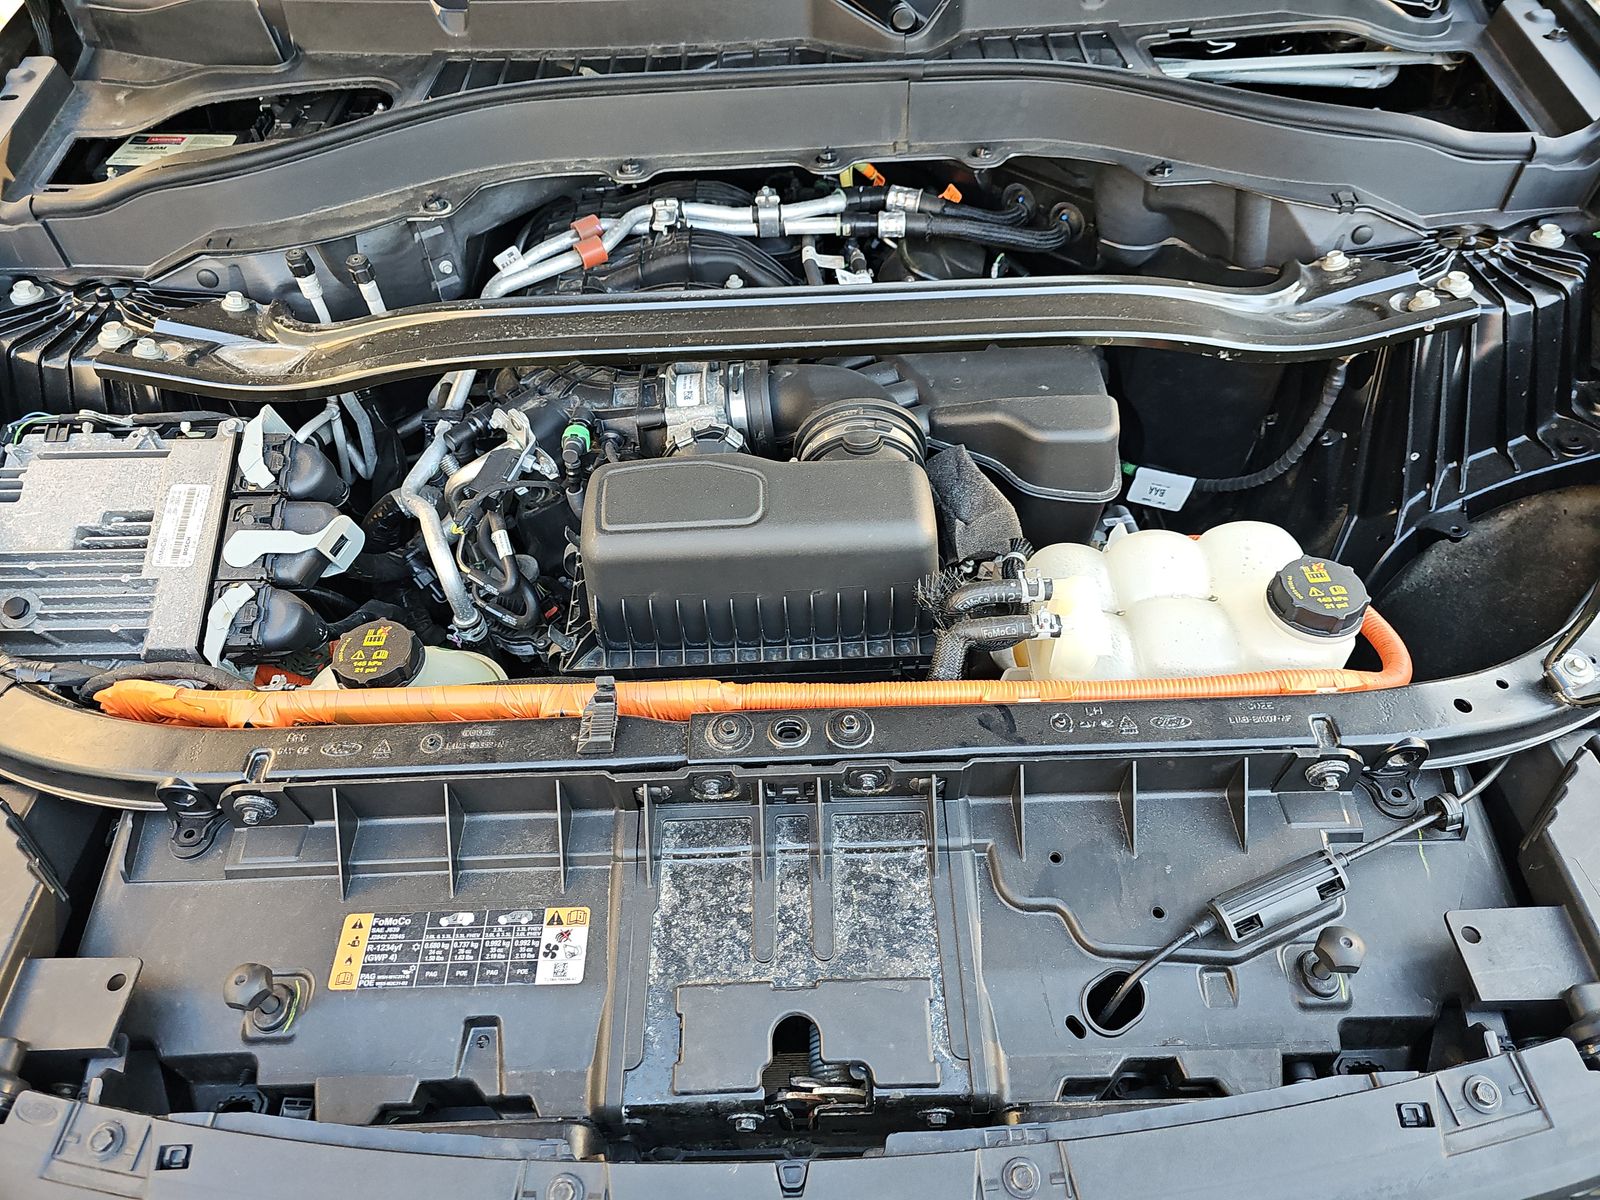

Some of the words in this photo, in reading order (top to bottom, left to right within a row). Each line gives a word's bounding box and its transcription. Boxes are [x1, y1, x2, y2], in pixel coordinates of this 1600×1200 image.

[183, 537, 191, 556] BOSCH
[960, 595, 990, 610] FoMoCo
[983, 626, 1017, 638] FoMoCo
[372, 917, 411, 926] FoMoCo
[441, 941, 450, 950] kg
[453, 940, 470, 949] 0.737
[470, 941, 479, 949] kg
[502, 940, 511, 948] kg
[531, 939, 540, 947] kg
[367, 944, 403, 953] R-1234yf
[364, 954, 388, 963] (GWP
[389, 953, 398, 962] 4)
